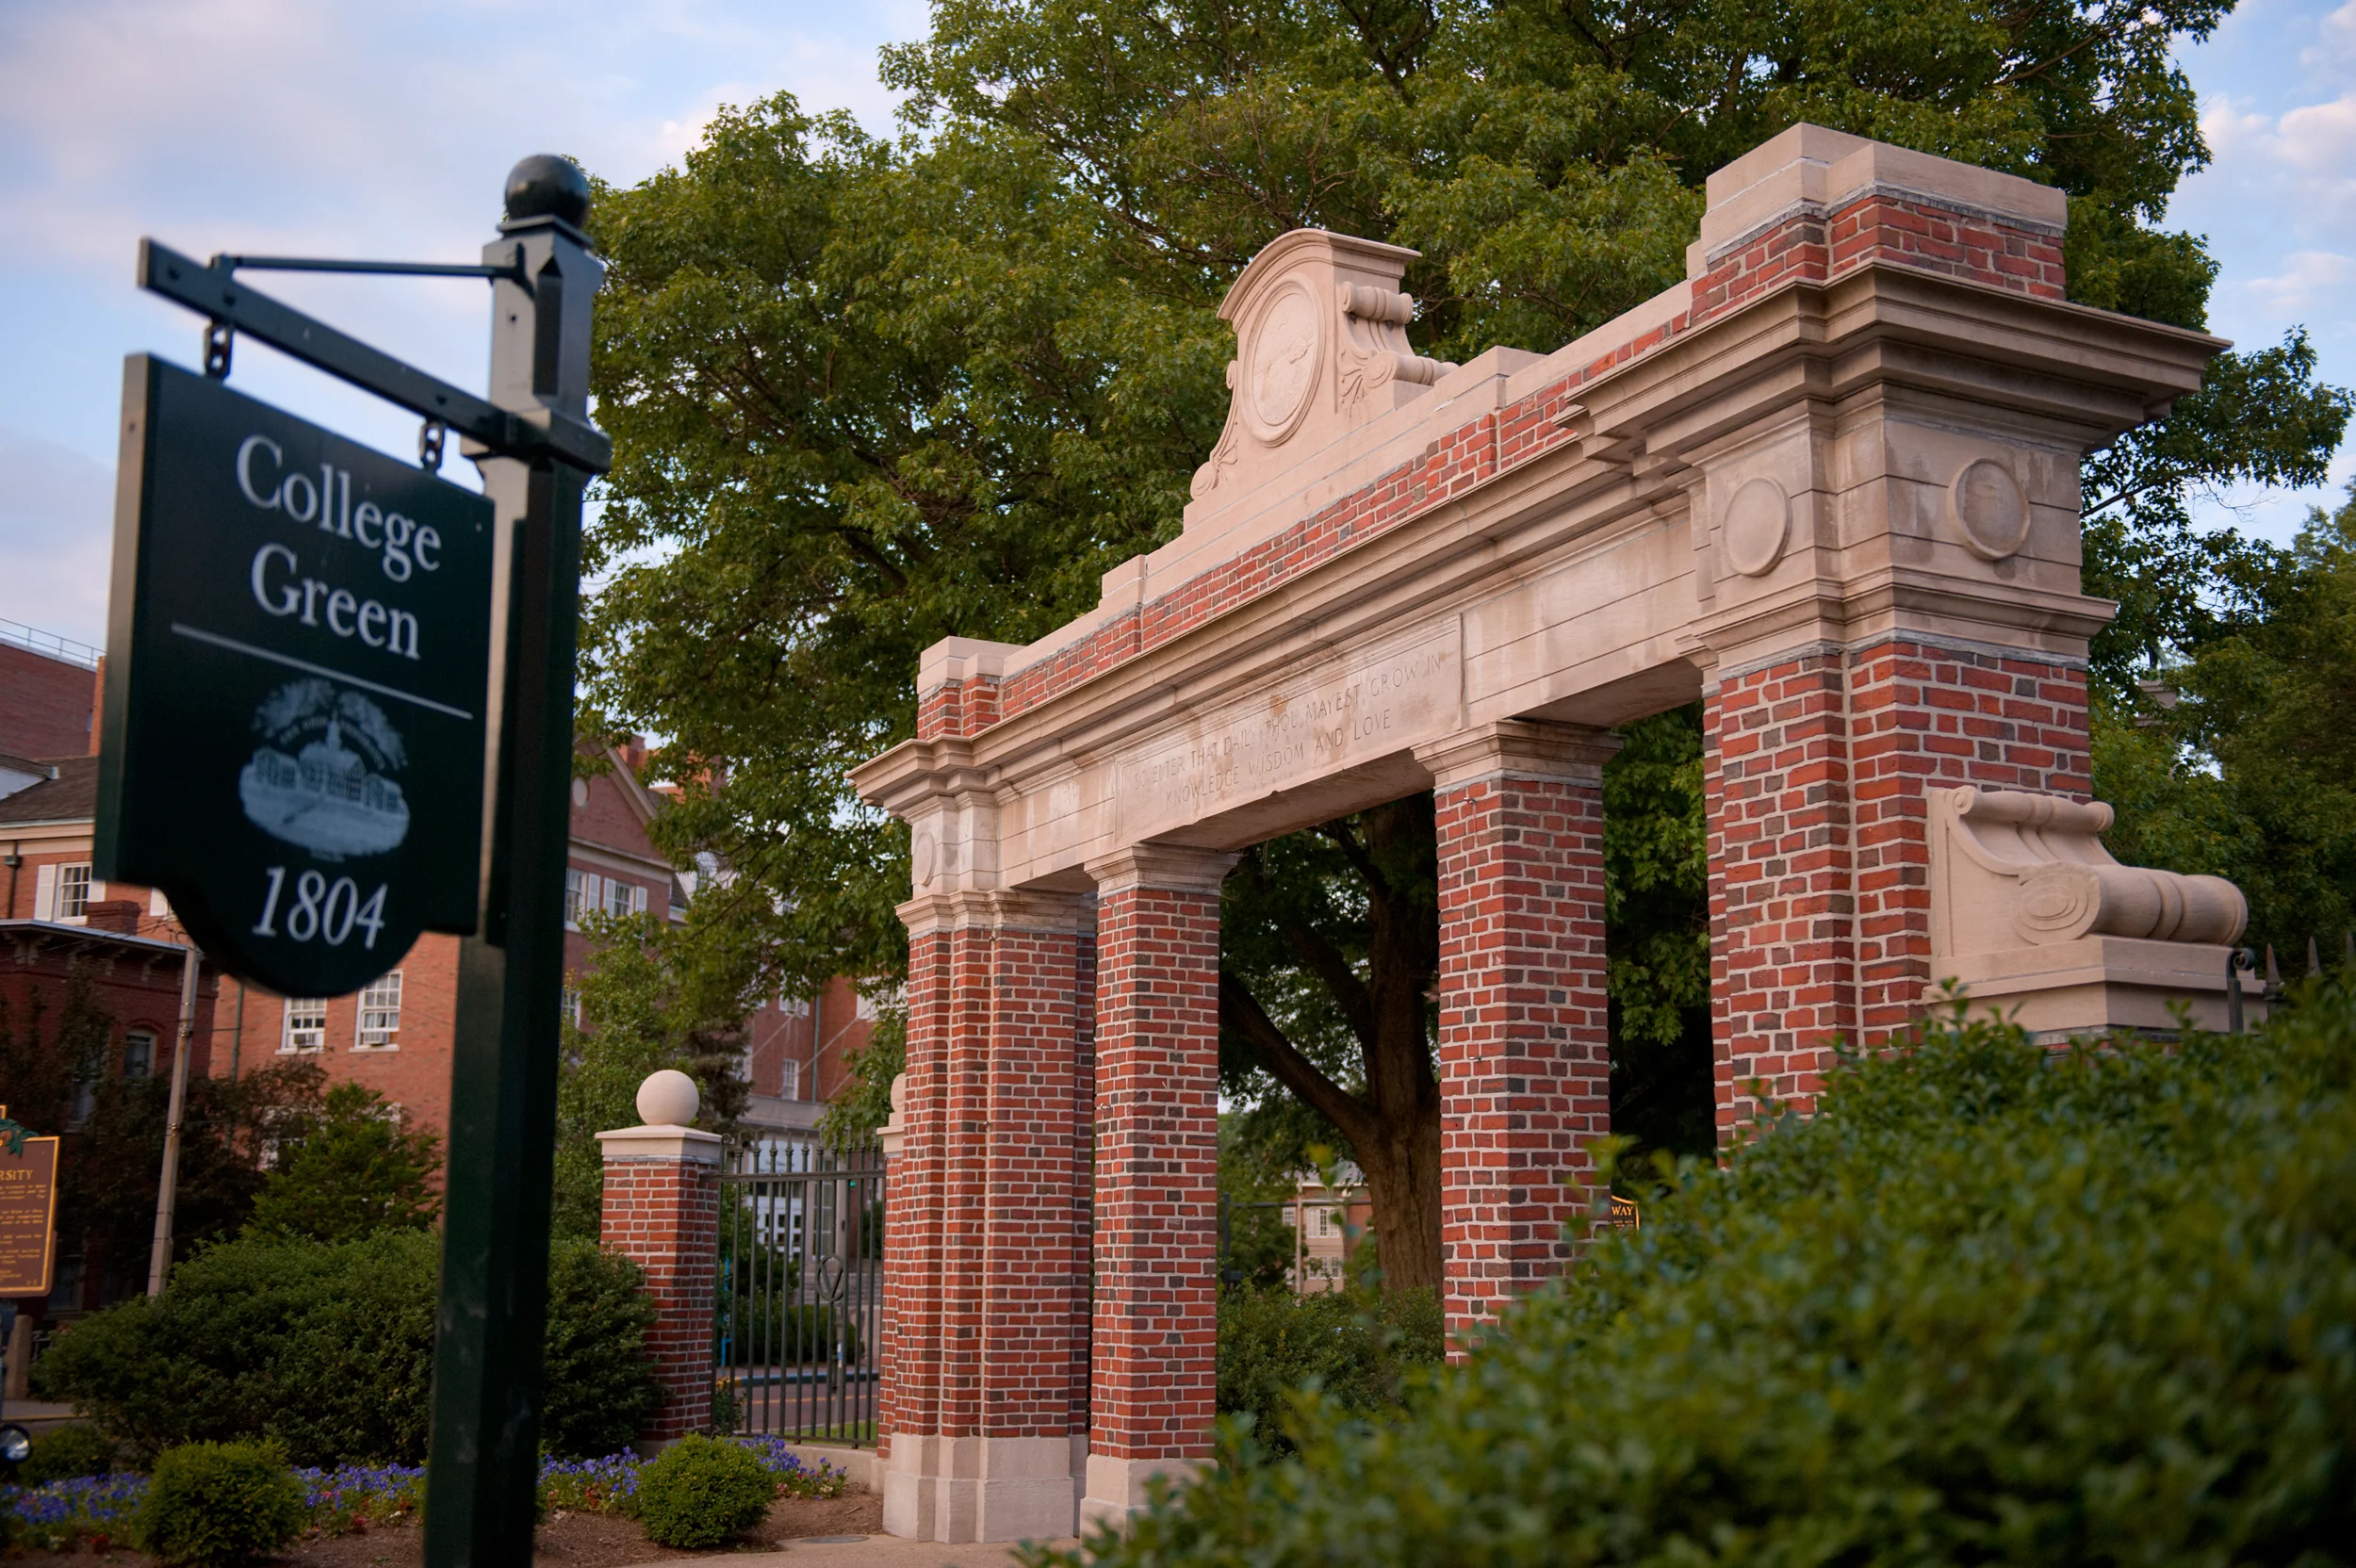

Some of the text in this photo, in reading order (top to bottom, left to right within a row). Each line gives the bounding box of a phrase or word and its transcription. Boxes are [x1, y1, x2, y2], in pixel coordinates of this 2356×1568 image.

[236, 433, 442, 583] College
[251, 580, 421, 661] Green
[1134, 654, 1442, 790] SO ENTER THAT DAILY THOU MAYEST GROW IN
[1166, 709, 1391, 809] KNOWLEDGE WISDOM AND LOVE
[251, 865, 388, 950] 1804
[1612, 1205, 1634, 1217] WAY
